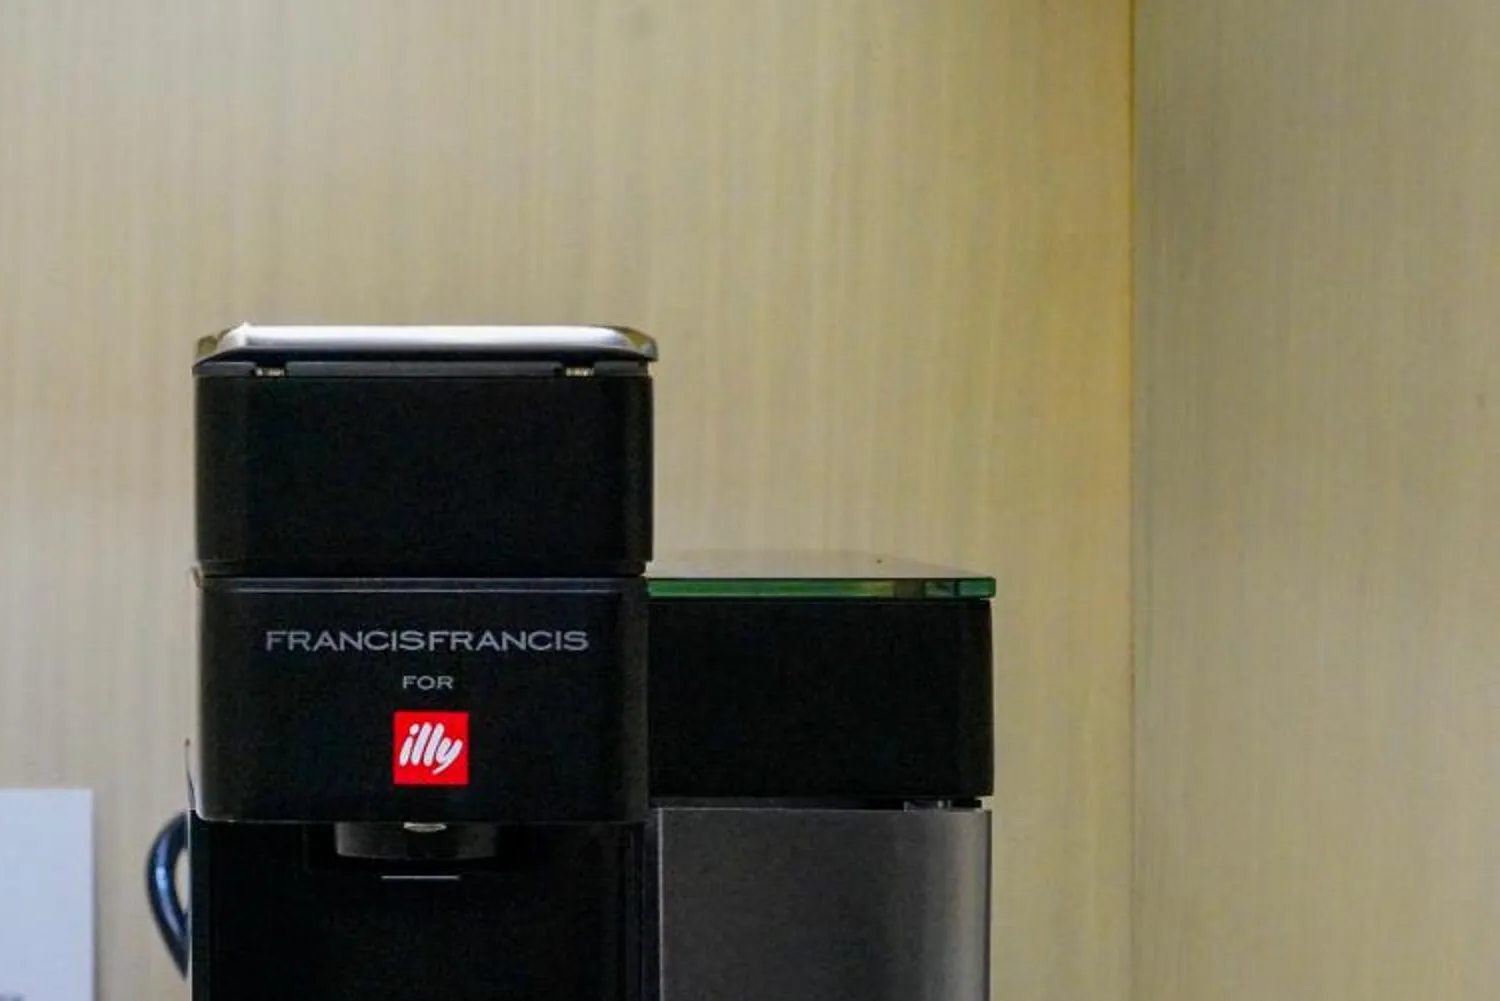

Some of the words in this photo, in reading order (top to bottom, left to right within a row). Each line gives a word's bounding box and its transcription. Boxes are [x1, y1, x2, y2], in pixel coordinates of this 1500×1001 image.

[264, 629, 590, 652] FRANCISFRANCIS
[402, 674, 455, 690] FOR
[399, 721, 464, 775] illy
